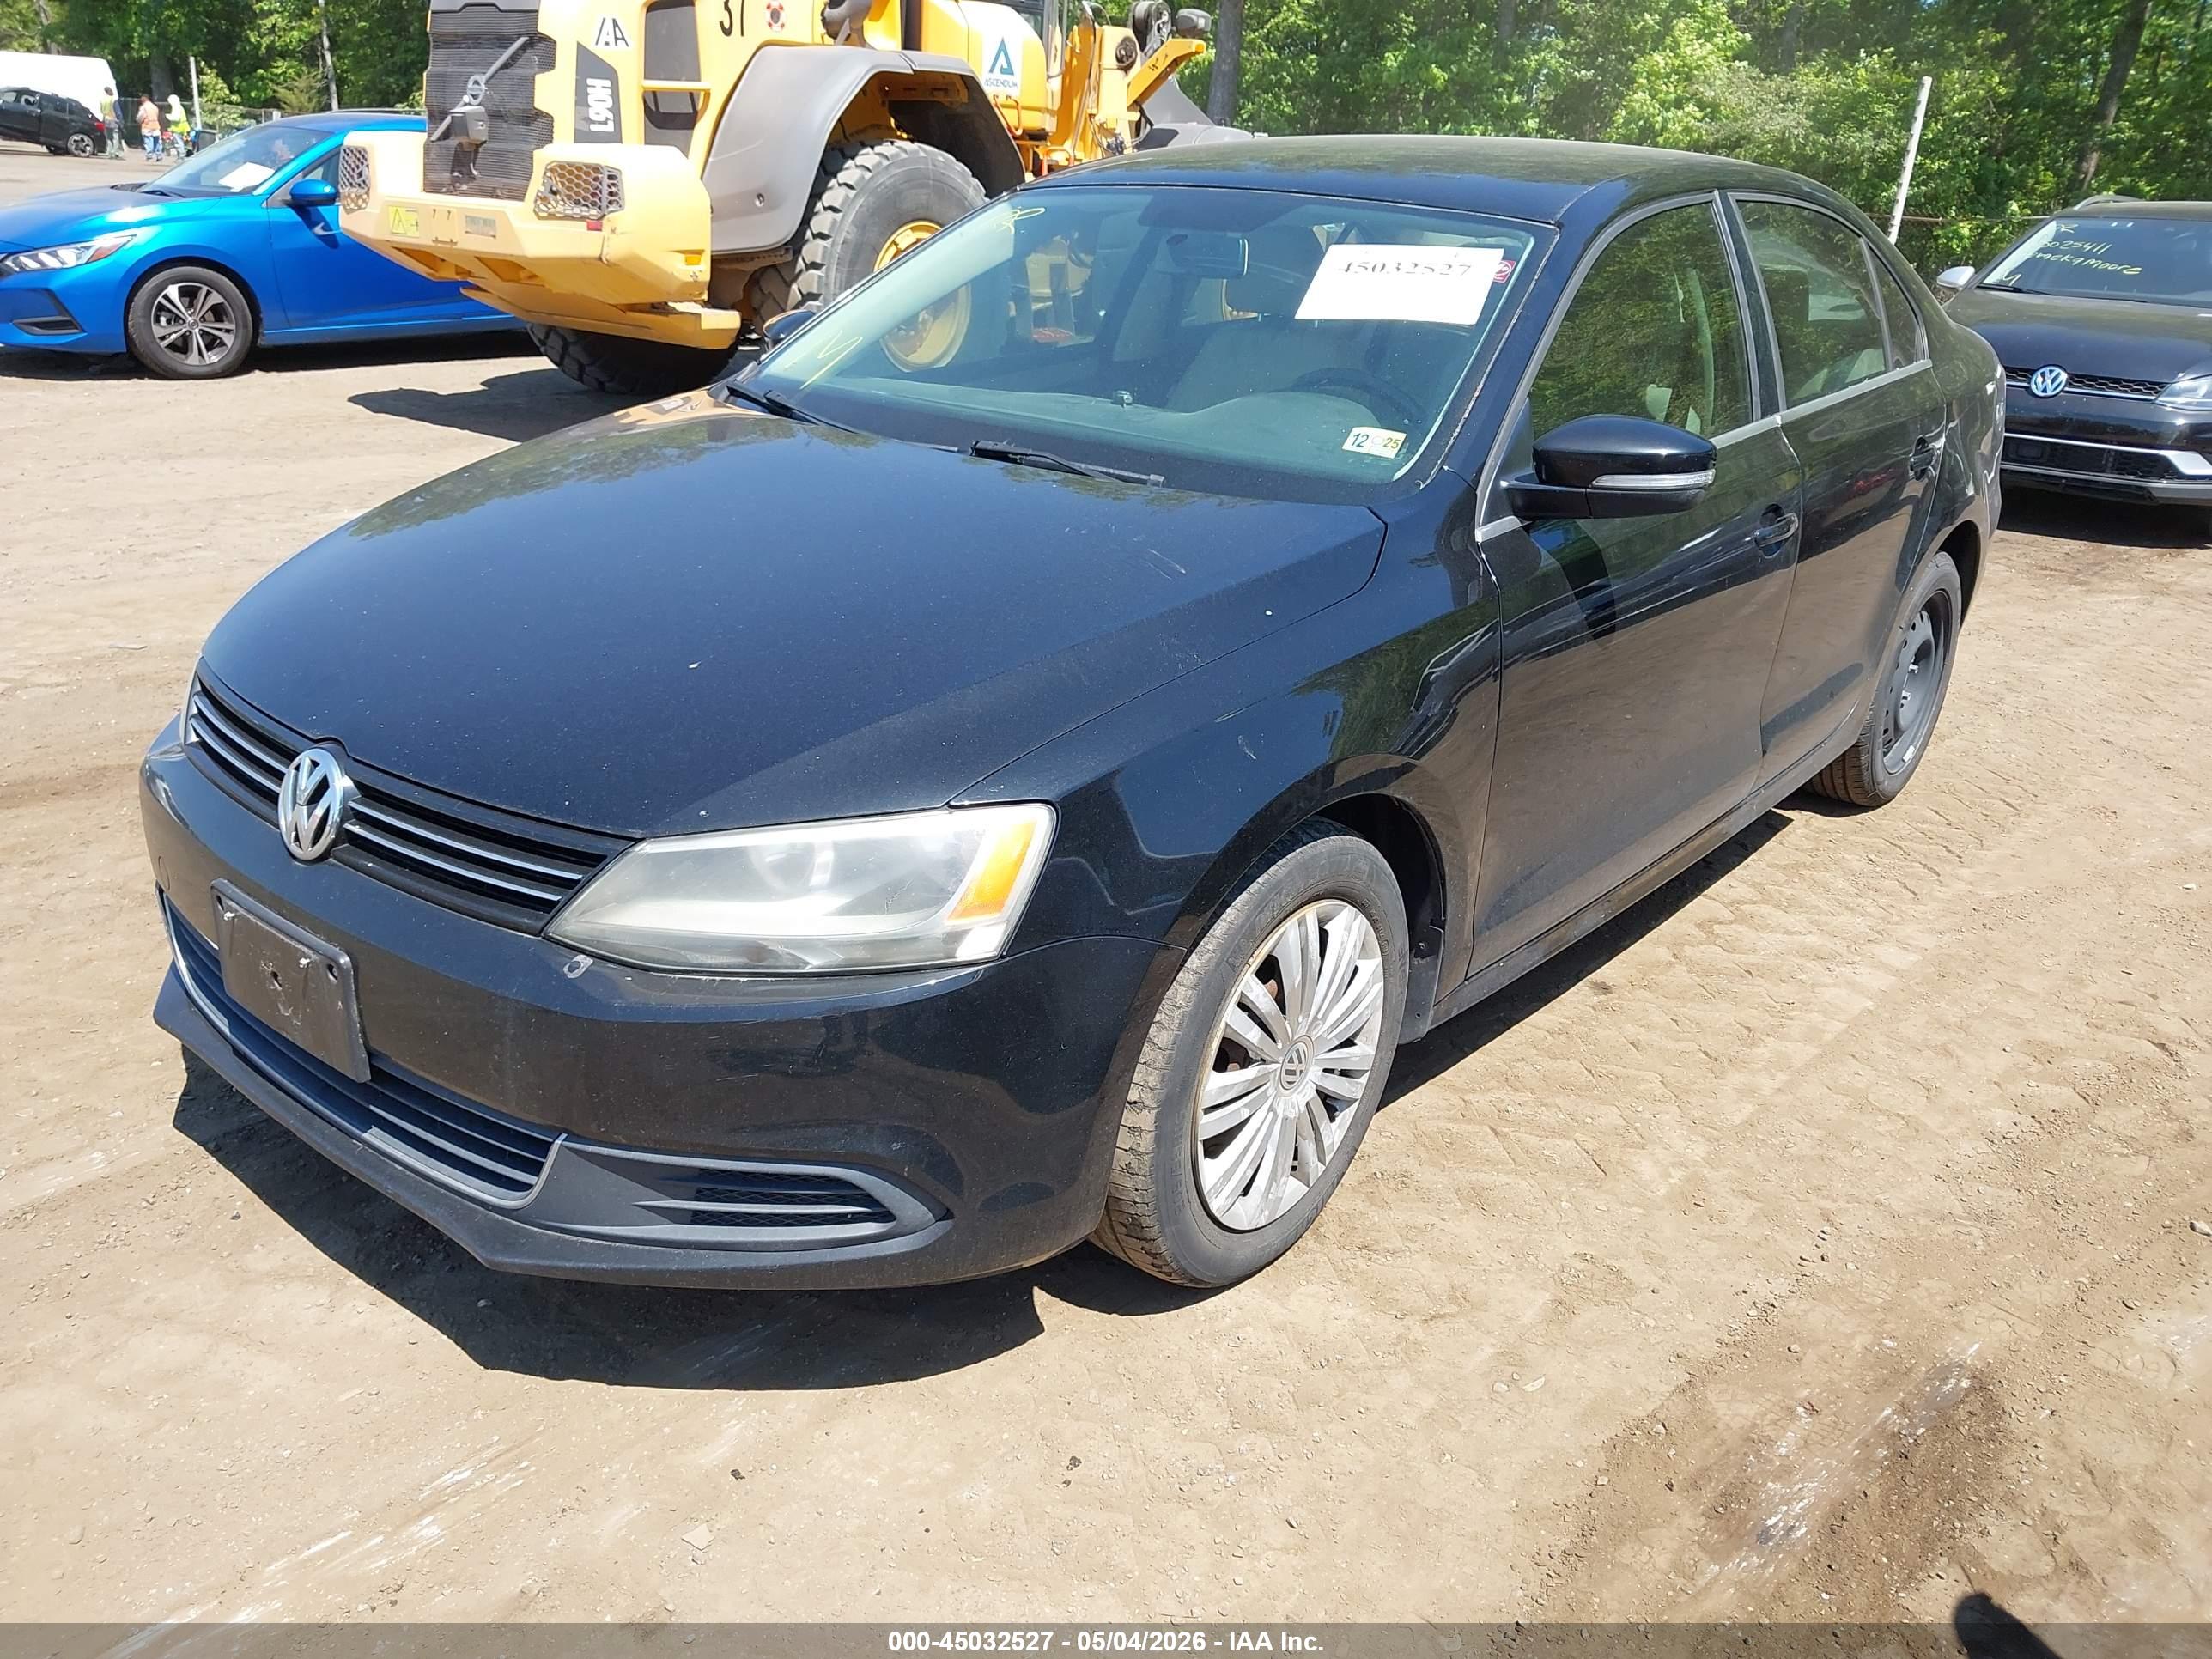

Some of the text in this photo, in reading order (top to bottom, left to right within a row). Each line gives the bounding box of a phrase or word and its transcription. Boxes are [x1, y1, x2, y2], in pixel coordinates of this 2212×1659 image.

[587, 78, 615, 133] L90H
[1340, 262, 1472, 276] 45032527
[1351, 433, 1401, 449] 12 25
